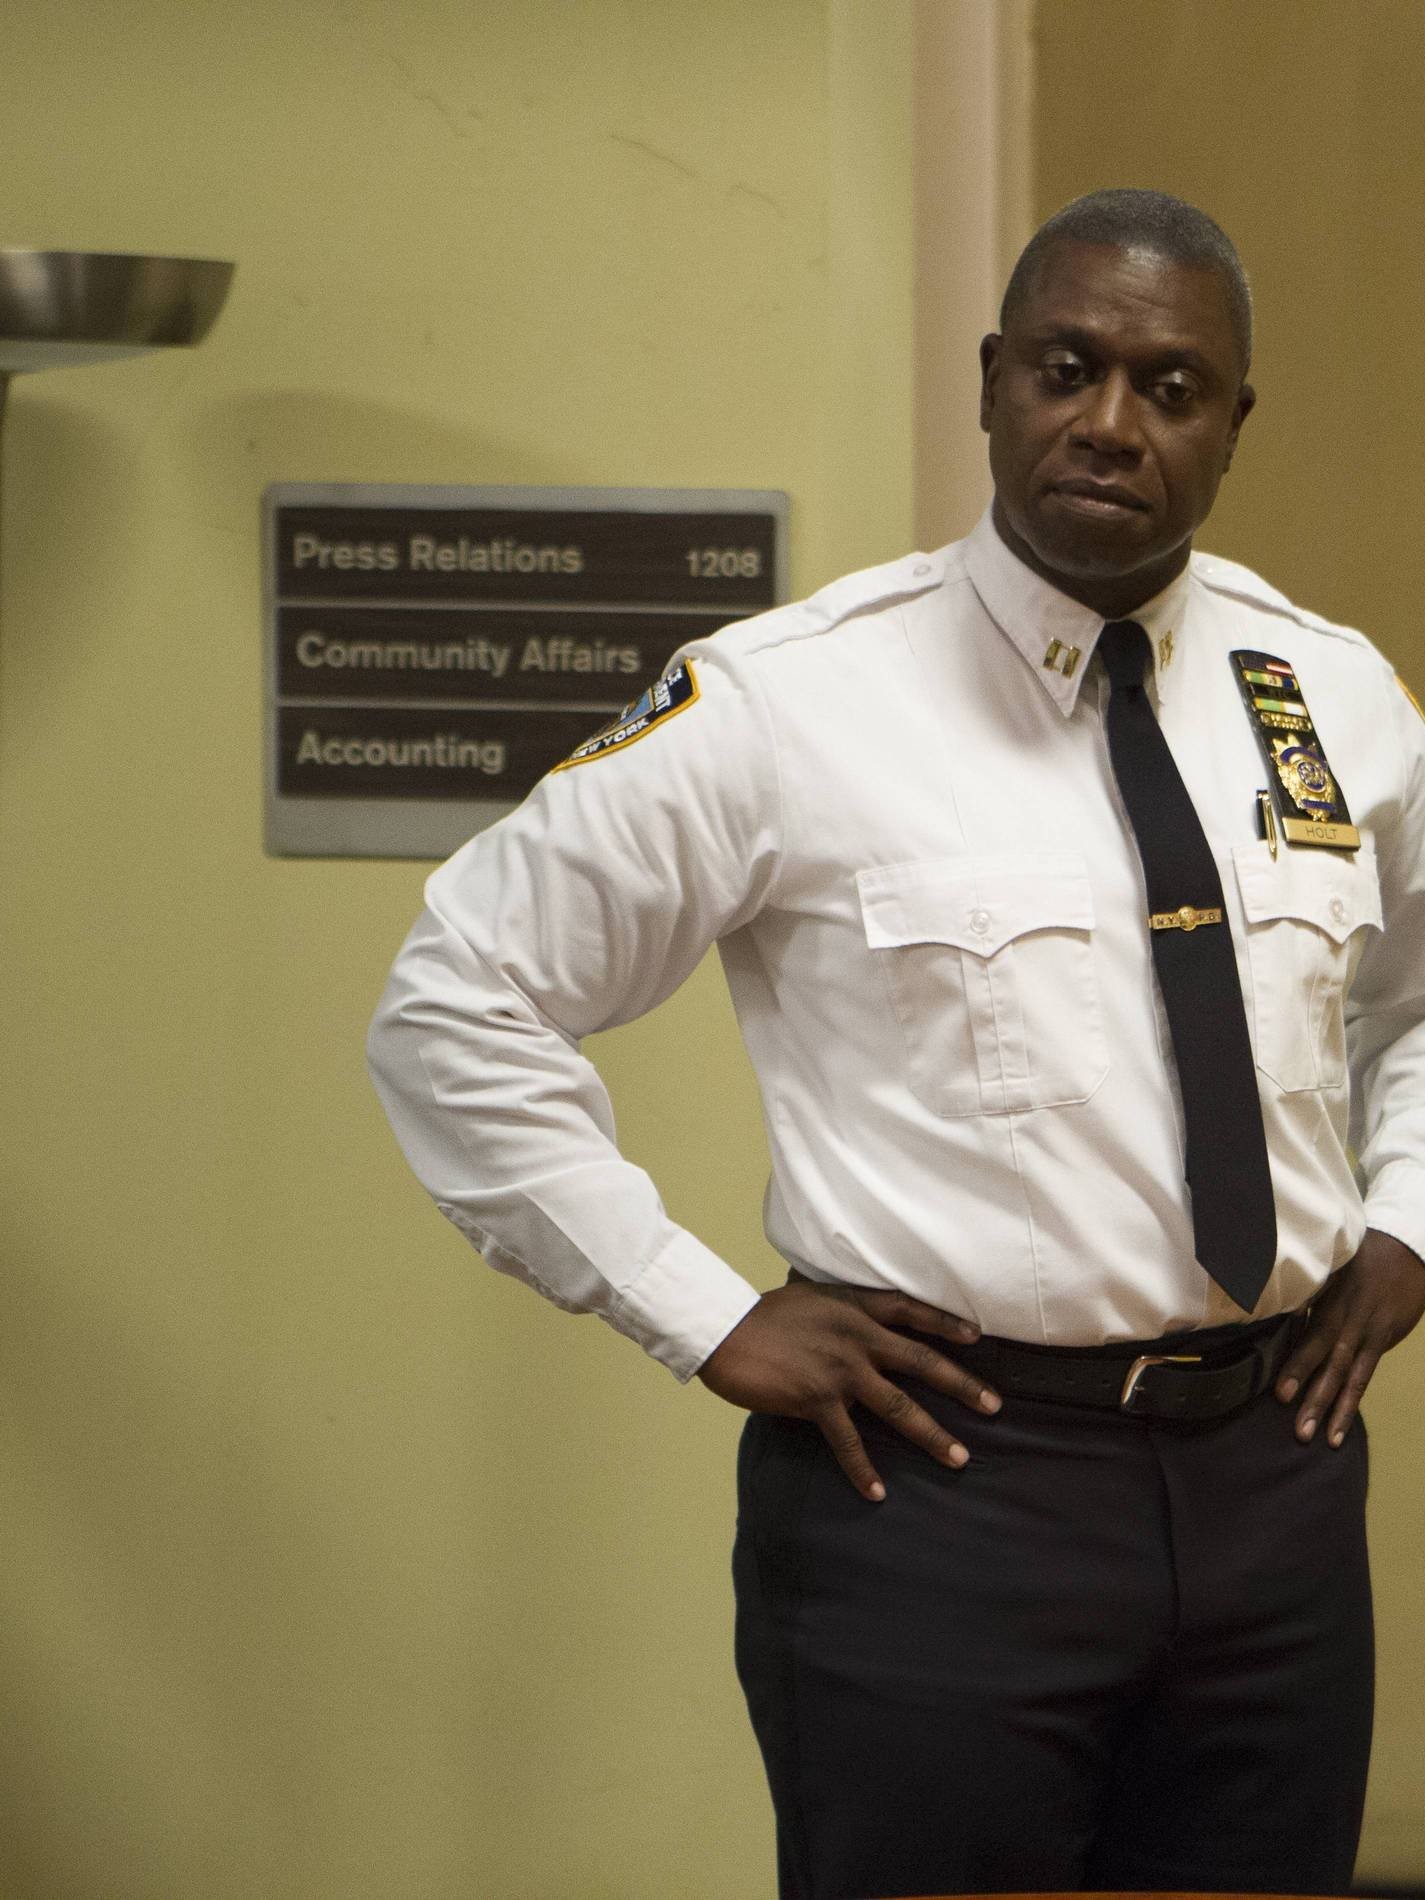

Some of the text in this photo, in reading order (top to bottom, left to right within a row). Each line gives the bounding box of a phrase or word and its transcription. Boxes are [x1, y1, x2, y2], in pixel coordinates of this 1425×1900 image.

[292, 533, 762, 579] Press Relations 1208
[294, 631, 642, 678] Community Affairs
[295, 729, 507, 775] Accounting
[603, 716, 650, 746] YORK
[1304, 825, 1337, 840] HOLT
